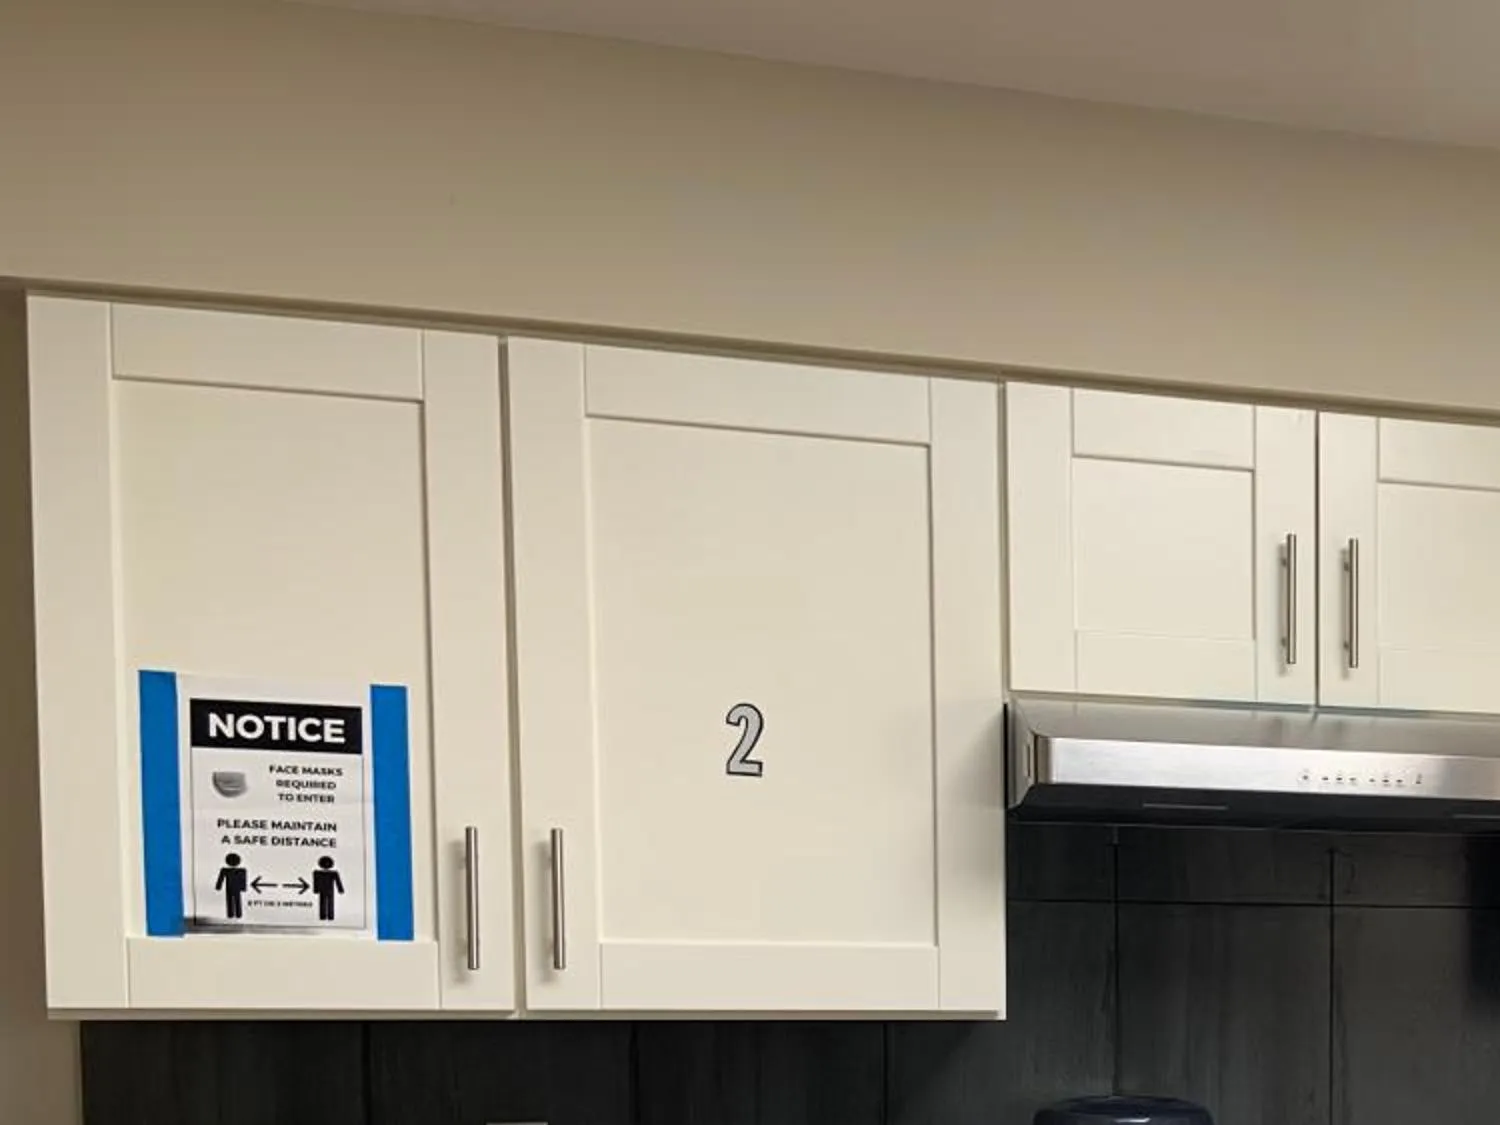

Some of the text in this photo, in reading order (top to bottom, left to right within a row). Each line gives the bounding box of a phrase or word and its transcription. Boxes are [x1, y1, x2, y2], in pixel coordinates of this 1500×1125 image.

[208, 712, 346, 744] NOTICE
[726, 702, 764, 777] 2
[269, 765, 343, 777] FACE MASKS
[275, 779, 337, 790] REQUIRED
[278, 793, 335, 803] TO ENTER
[217, 818, 337, 832] PLEASE MAINTAIN
[221, 835, 337, 848] A SAFE DISTANCE
